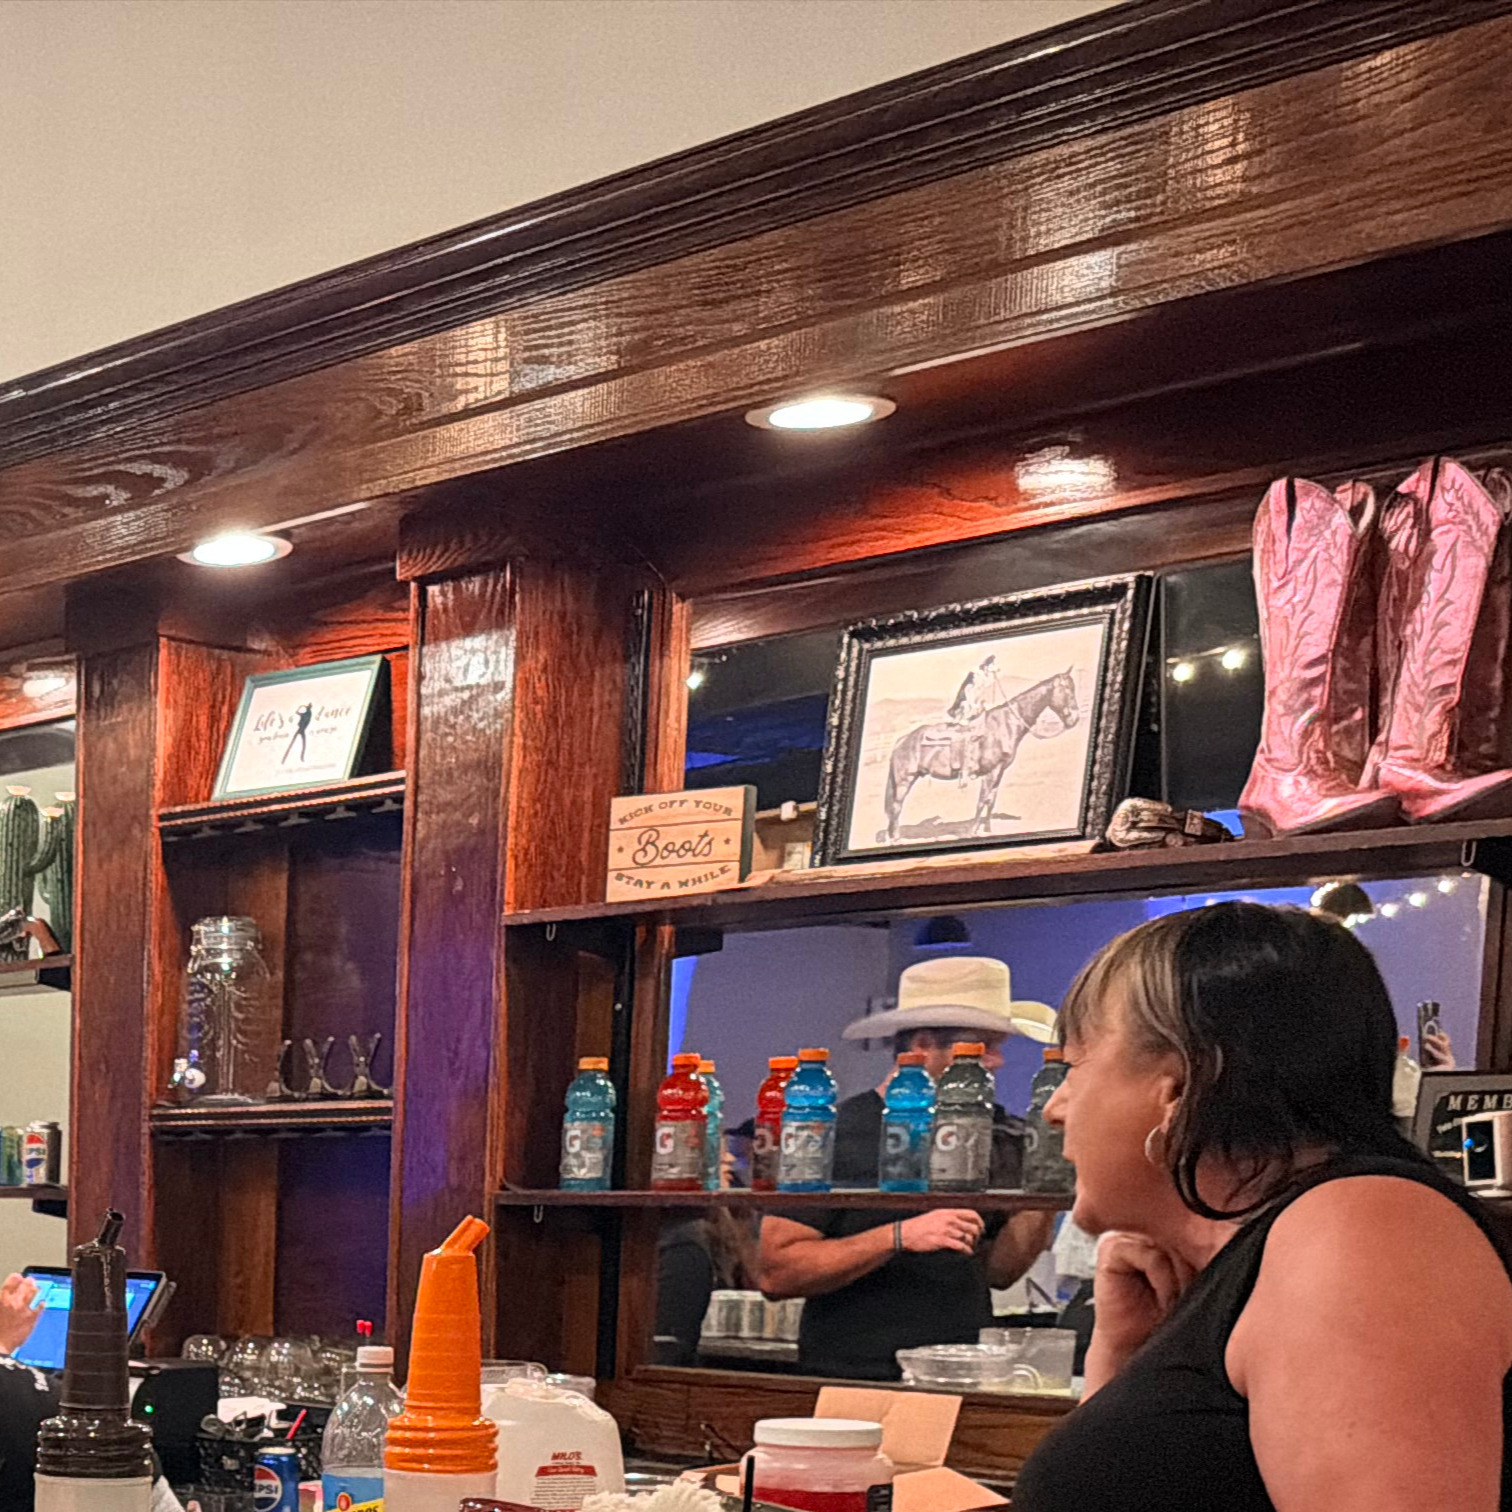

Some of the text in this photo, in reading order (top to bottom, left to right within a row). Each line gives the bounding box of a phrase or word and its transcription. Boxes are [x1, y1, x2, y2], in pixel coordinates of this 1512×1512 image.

[618, 799, 733, 826] KICK OFF YOUR
[632, 827, 715, 867] Boots
[614, 864, 732, 890] STAY A WHILE
[566, 1129, 581, 1153] G
[655, 1126, 675, 1155] G
[936, 1125, 958, 1151] G
[253, 1484, 278, 1495] PSI
